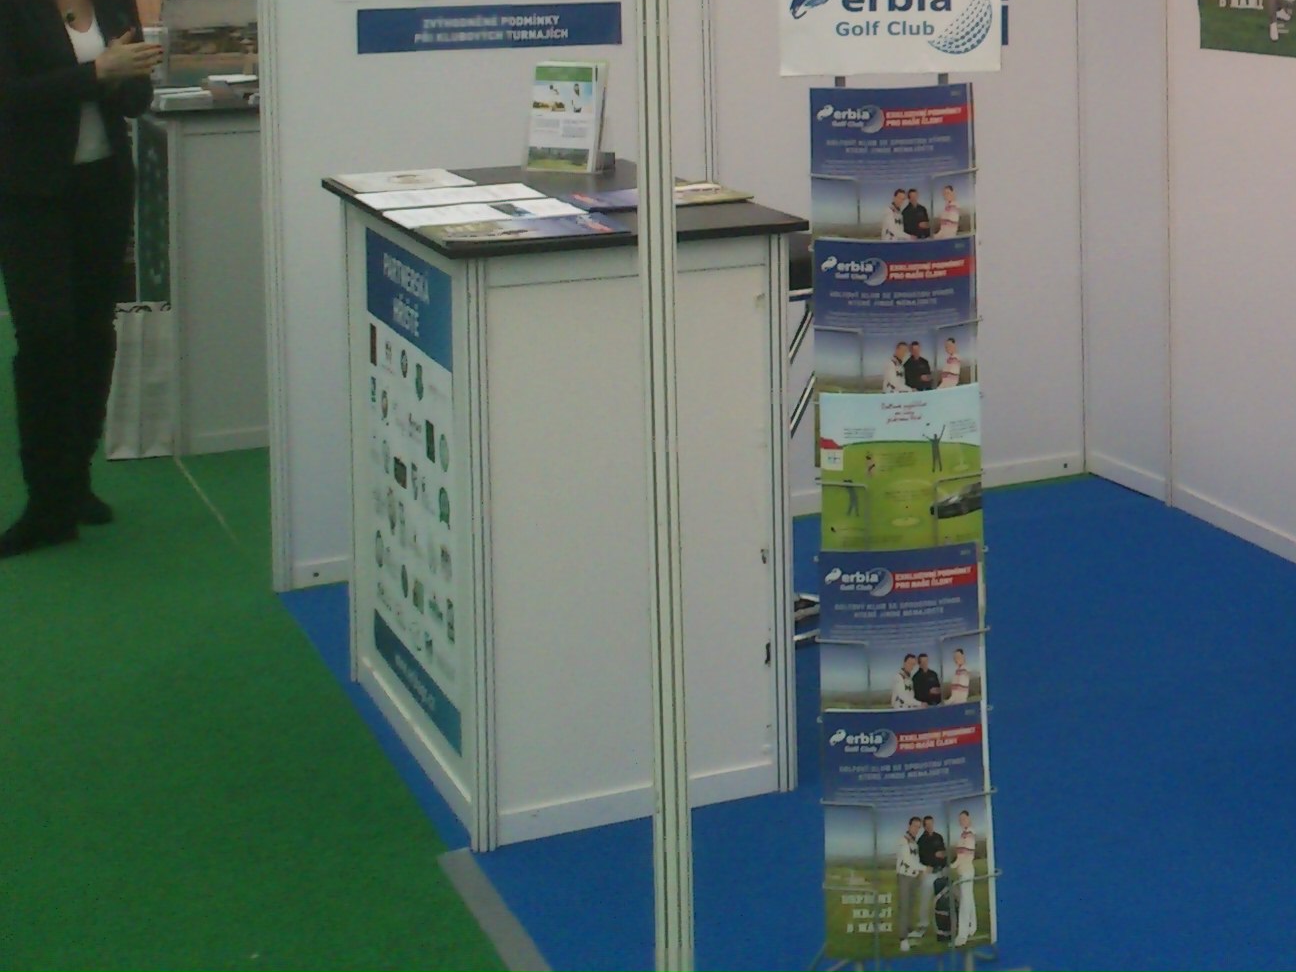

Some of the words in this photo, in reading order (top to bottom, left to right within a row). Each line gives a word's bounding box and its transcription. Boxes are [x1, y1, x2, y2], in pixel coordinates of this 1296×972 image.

[501, 14, 560, 27] PODMÍNKY
[836, 21, 881, 37] Golf
[888, 21, 935, 36] Club
[834, 108, 870, 120] erbia
[837, 261, 873, 272] erbia
[842, 571, 879, 583] erbia
[846, 732, 882, 744] erbia
